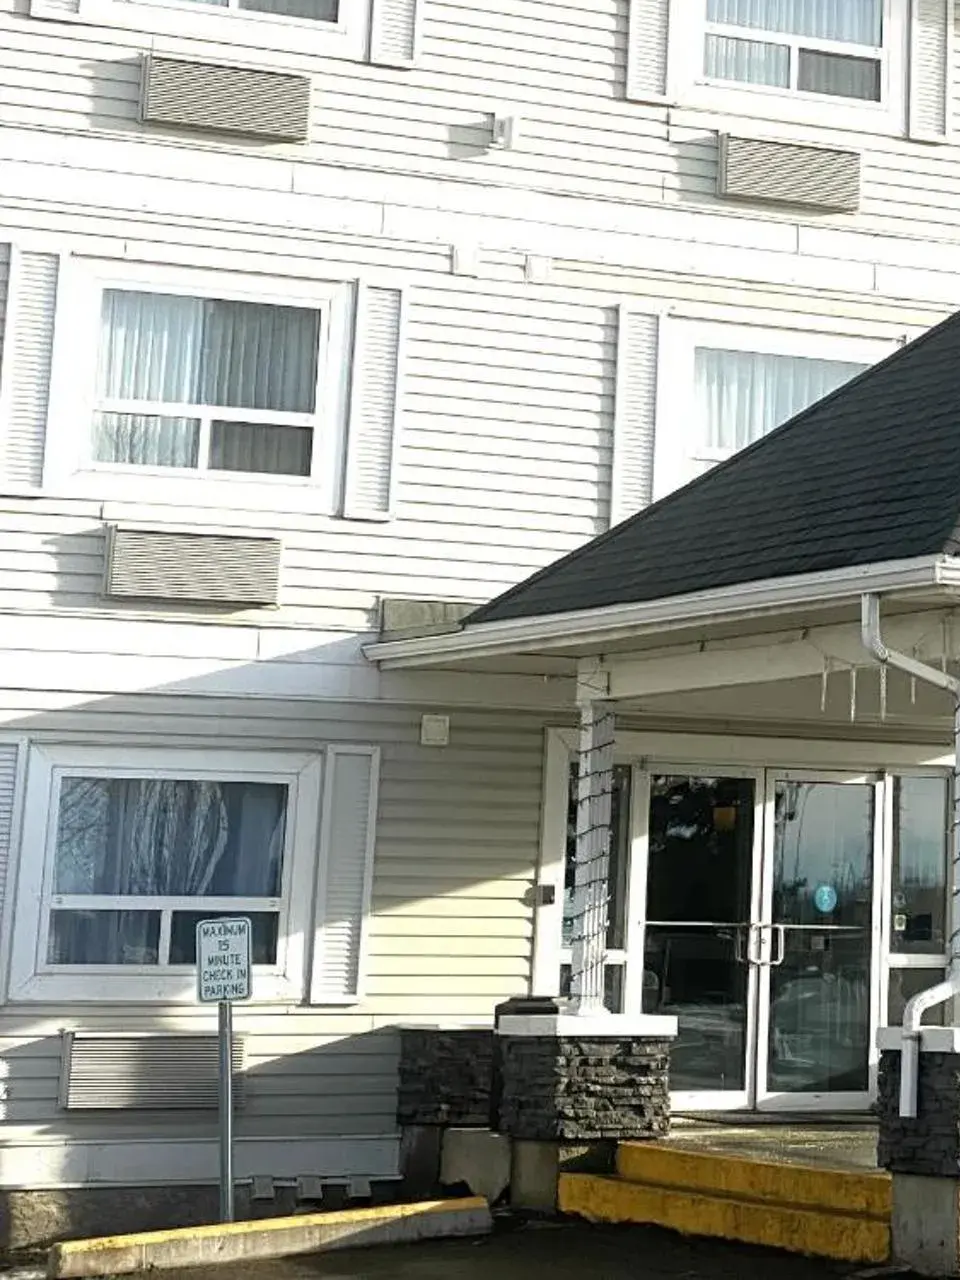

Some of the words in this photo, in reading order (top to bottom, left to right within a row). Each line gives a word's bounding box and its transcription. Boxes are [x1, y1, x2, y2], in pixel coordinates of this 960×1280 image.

[202, 924, 247, 937] MAXIMUM
[207, 953, 242, 966] MINUTE
[202, 969, 233, 982] CHECK
[236, 968, 247, 980] IN
[203, 983, 245, 997] PARKING
